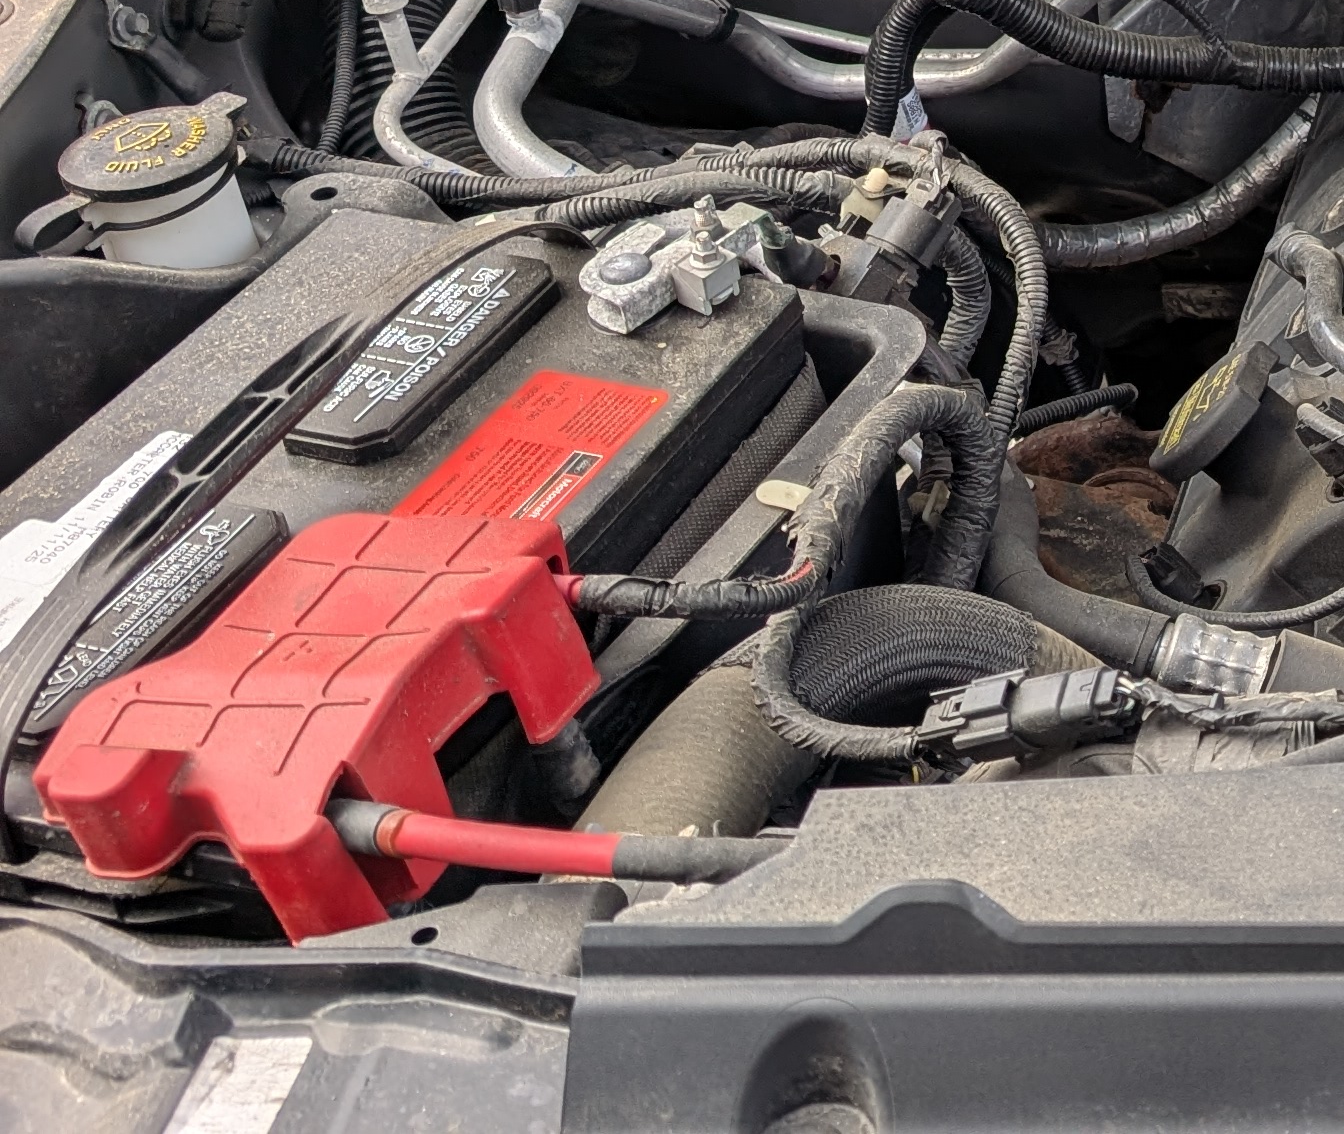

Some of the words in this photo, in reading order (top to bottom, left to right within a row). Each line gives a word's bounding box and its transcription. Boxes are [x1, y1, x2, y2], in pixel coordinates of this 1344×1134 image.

[91, 117, 132, 142] ONLY
[171, 116, 208, 158] WASHER
[105, 155, 165, 173] FLUID
[440, 299, 501, 347] DANGER
[382, 356, 441, 400] POISON
[525, 478, 576, 518] Motorcraft
[152, 541, 193, 573] MEDICAL
[177, 543, 204, 562] WITH
[183, 545, 215, 569] FLUSH
[132, 573, 160, 593] HELP
[161, 568, 190, 588] EYES
[110, 592, 139, 612] FAST
[129, 590, 154, 606] GET
[108, 588, 168, 637] IMMEDIATELY
